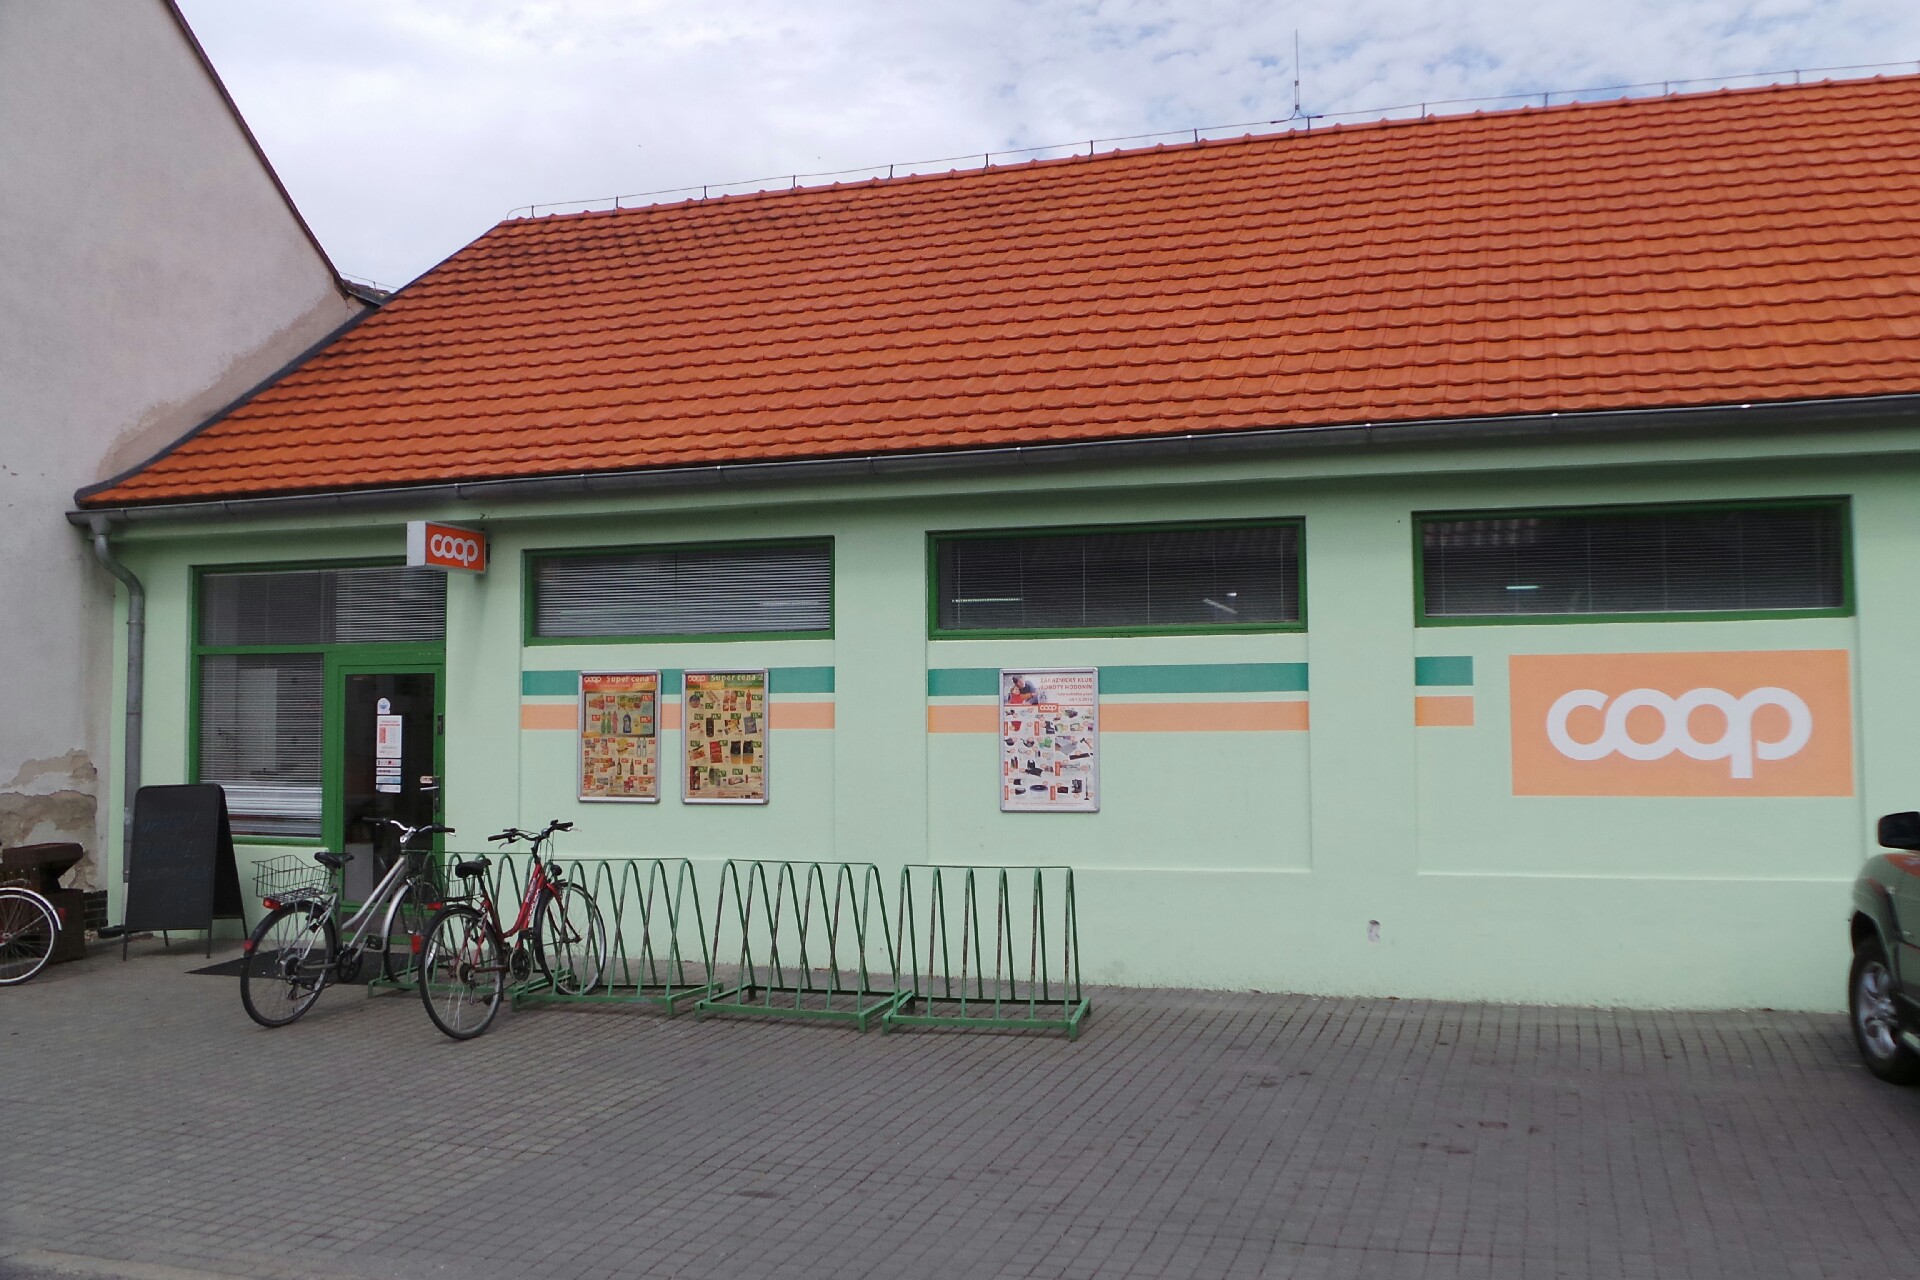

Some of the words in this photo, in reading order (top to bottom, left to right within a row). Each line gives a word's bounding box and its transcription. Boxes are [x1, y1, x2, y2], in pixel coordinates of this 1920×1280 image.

[430, 534, 478, 566] coop
[606, 676, 629, 684] Super
[1546, 686, 1812, 778] coop
